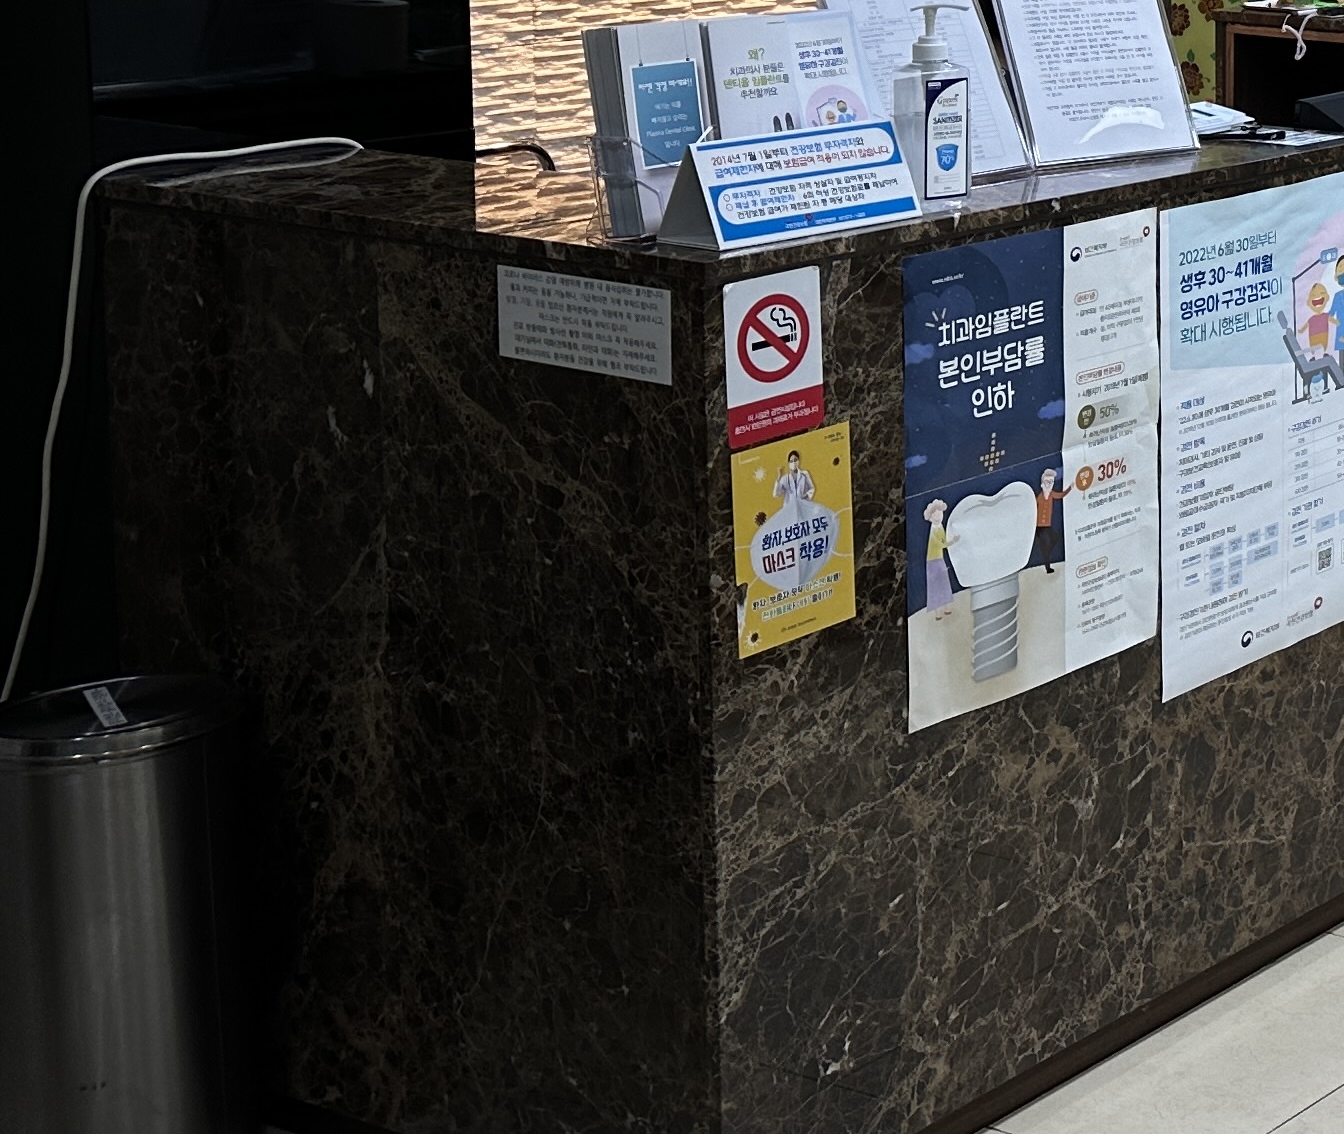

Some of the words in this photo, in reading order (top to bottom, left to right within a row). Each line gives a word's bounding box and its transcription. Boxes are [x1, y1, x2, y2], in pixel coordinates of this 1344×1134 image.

[710, 152, 742, 166] 2014년
[743, 152, 757, 162] 7월
[759, 147, 789, 160] 1일부터
[790, 142, 822, 154] 건강보험
[841, 148, 857, 160] 되지
[1179, 245, 1216, 267] 2022년
[1218, 240, 1235, 256] 6월
[1236, 230, 1277, 254] 30일부터
[1179, 270, 1207, 295] 생후
[1208, 253, 1274, 286] 30~41개월
[1180, 292, 1219, 321] 영유아
[1221, 276, 1283, 309] 구강검진이
[938, 300, 1045, 347] 치과임플란트
[1180, 322, 1207, 346] 확대
[1208, 306, 1274, 340] 시행됩니다.
[938, 336, 1045, 389] 본인부담률
[971, 381, 1015, 418] 인하
[1097, 457, 1127, 483] 30%
[762, 520, 810, 551] 환자,보호자
[812, 516, 828, 534] 모두
[762, 547, 795, 574] 마스크
[799, 535, 829, 561] 착용!
